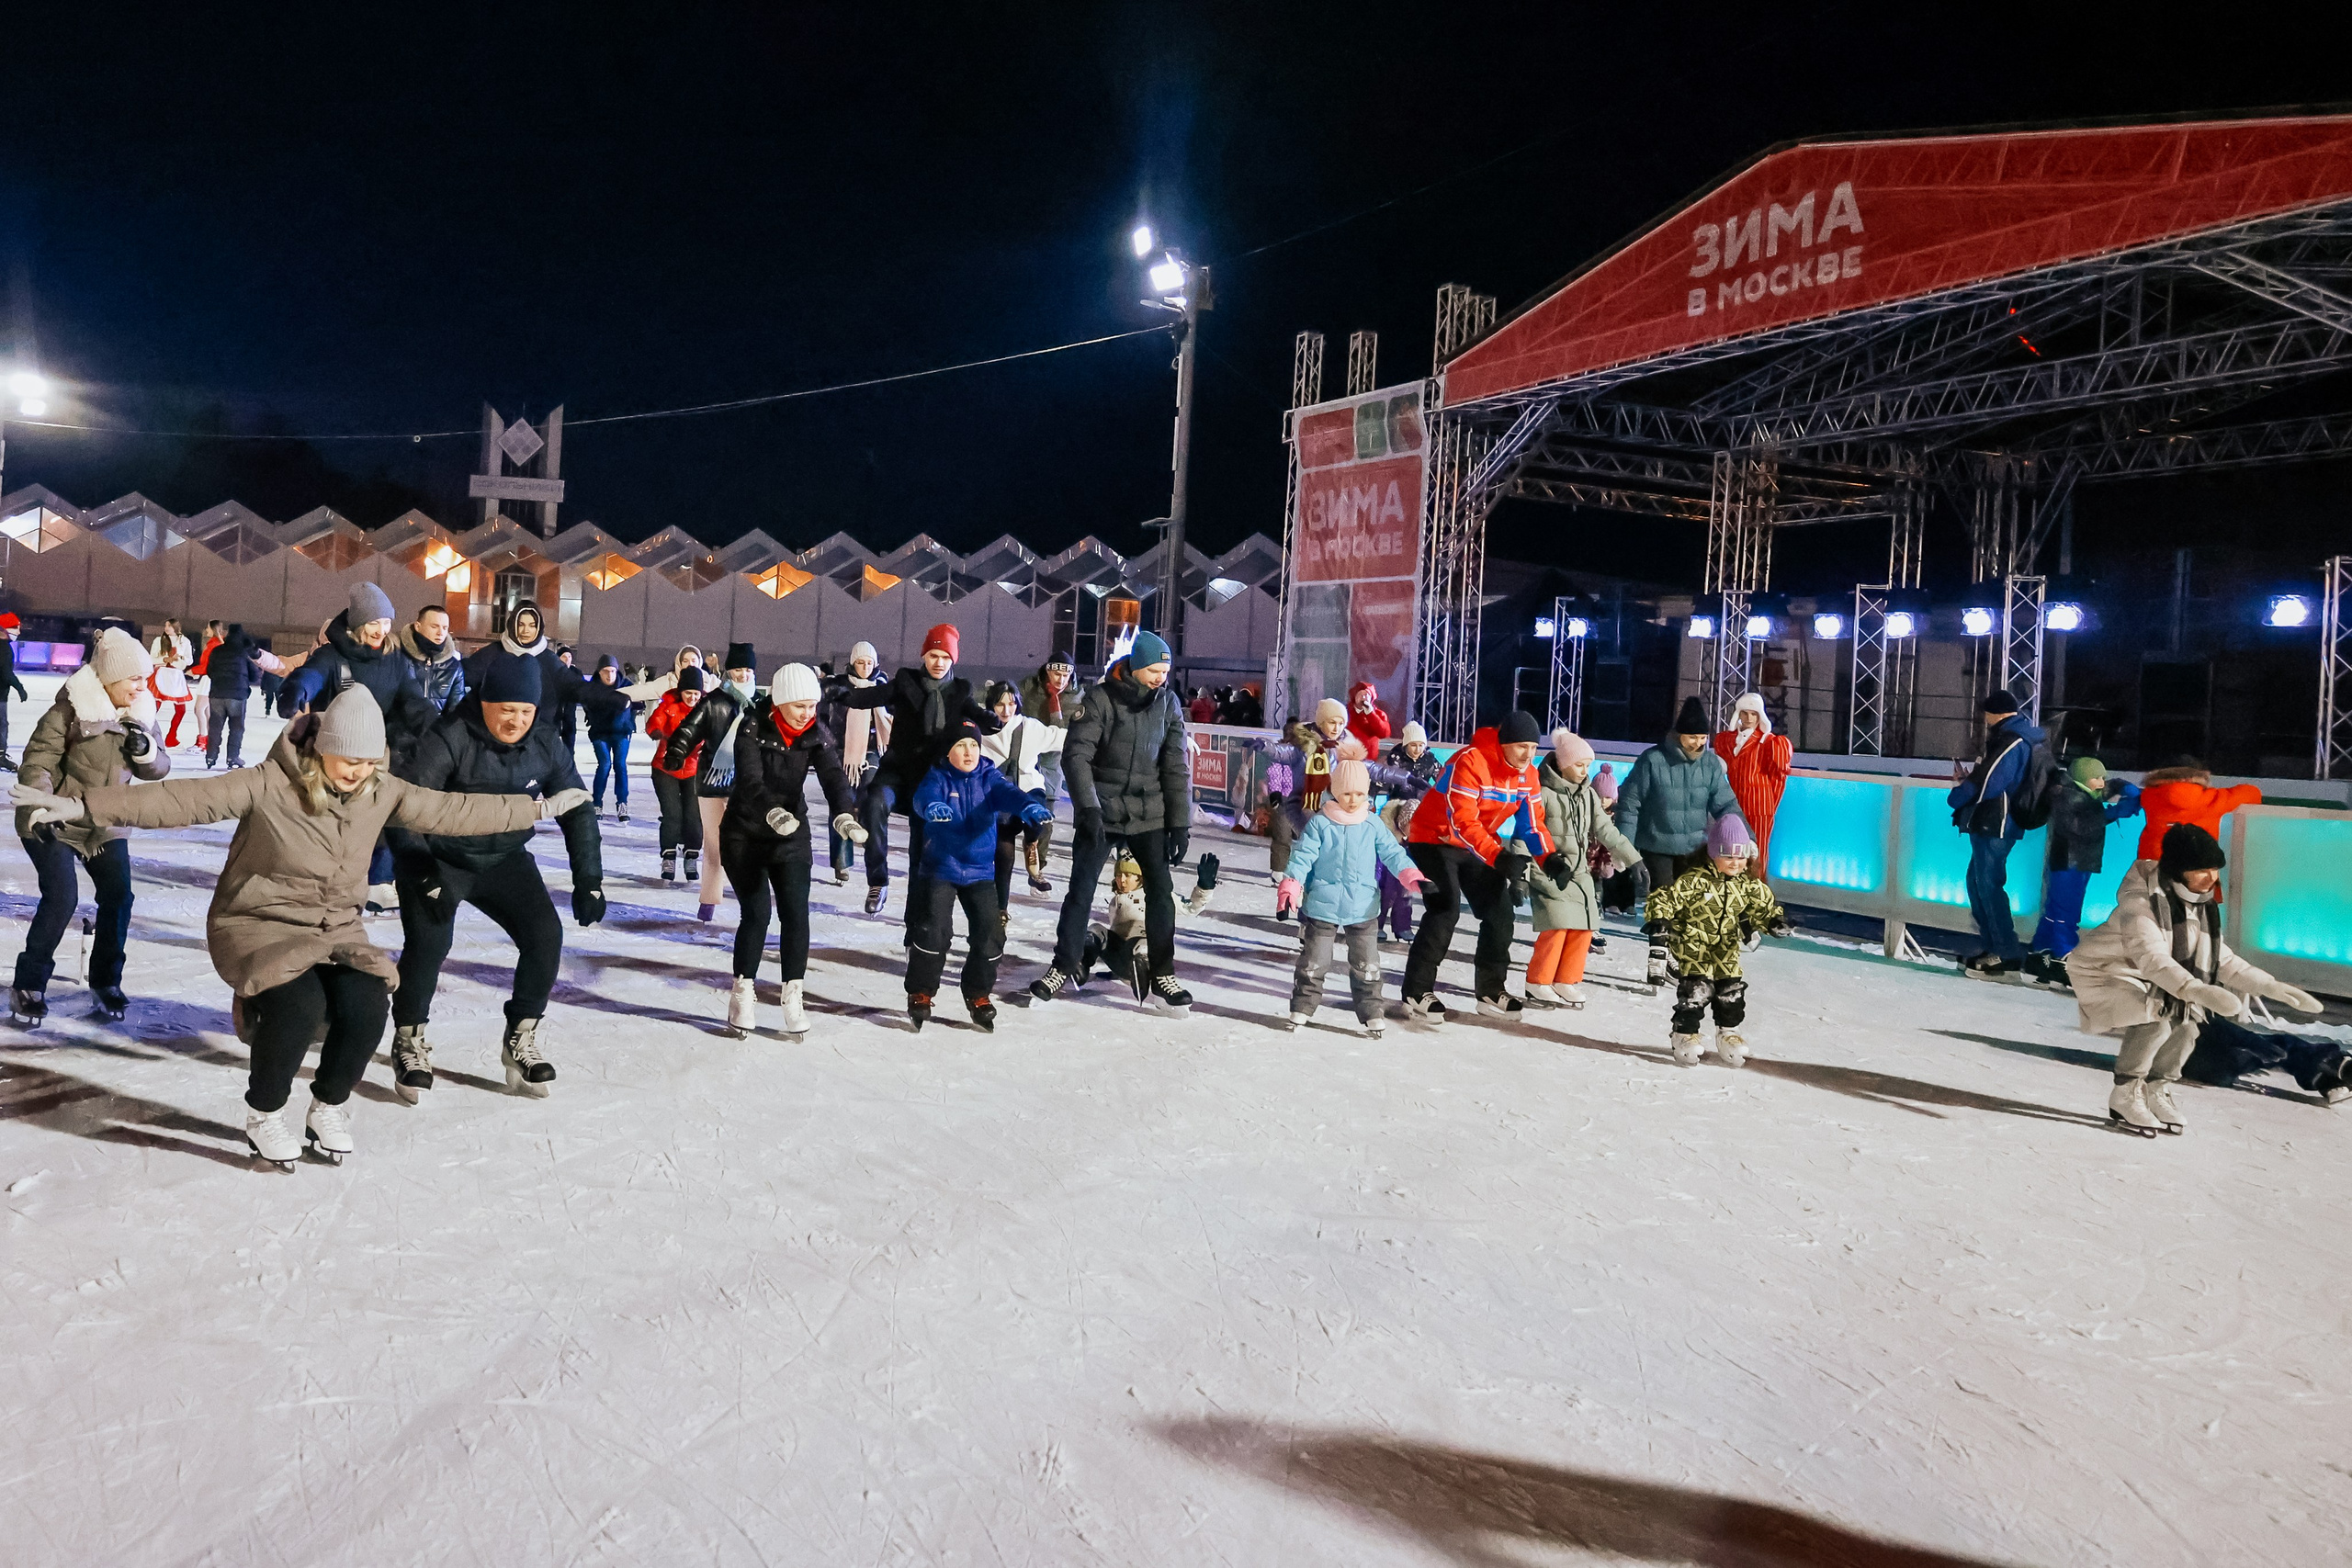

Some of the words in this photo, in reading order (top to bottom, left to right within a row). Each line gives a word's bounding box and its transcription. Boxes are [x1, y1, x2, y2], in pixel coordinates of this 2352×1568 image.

[1689, 181, 1864, 278] ЗИМА
[1687, 288, 1707, 317] В
[1717, 245, 1864, 310] МОСКВЕ
[1307, 479, 1405, 532] ЗИМА
[1308, 539, 1321, 561] В
[1325, 531, 1404, 561] МОСКВЕ
[1197, 758, 1222, 773] ЗИМА
